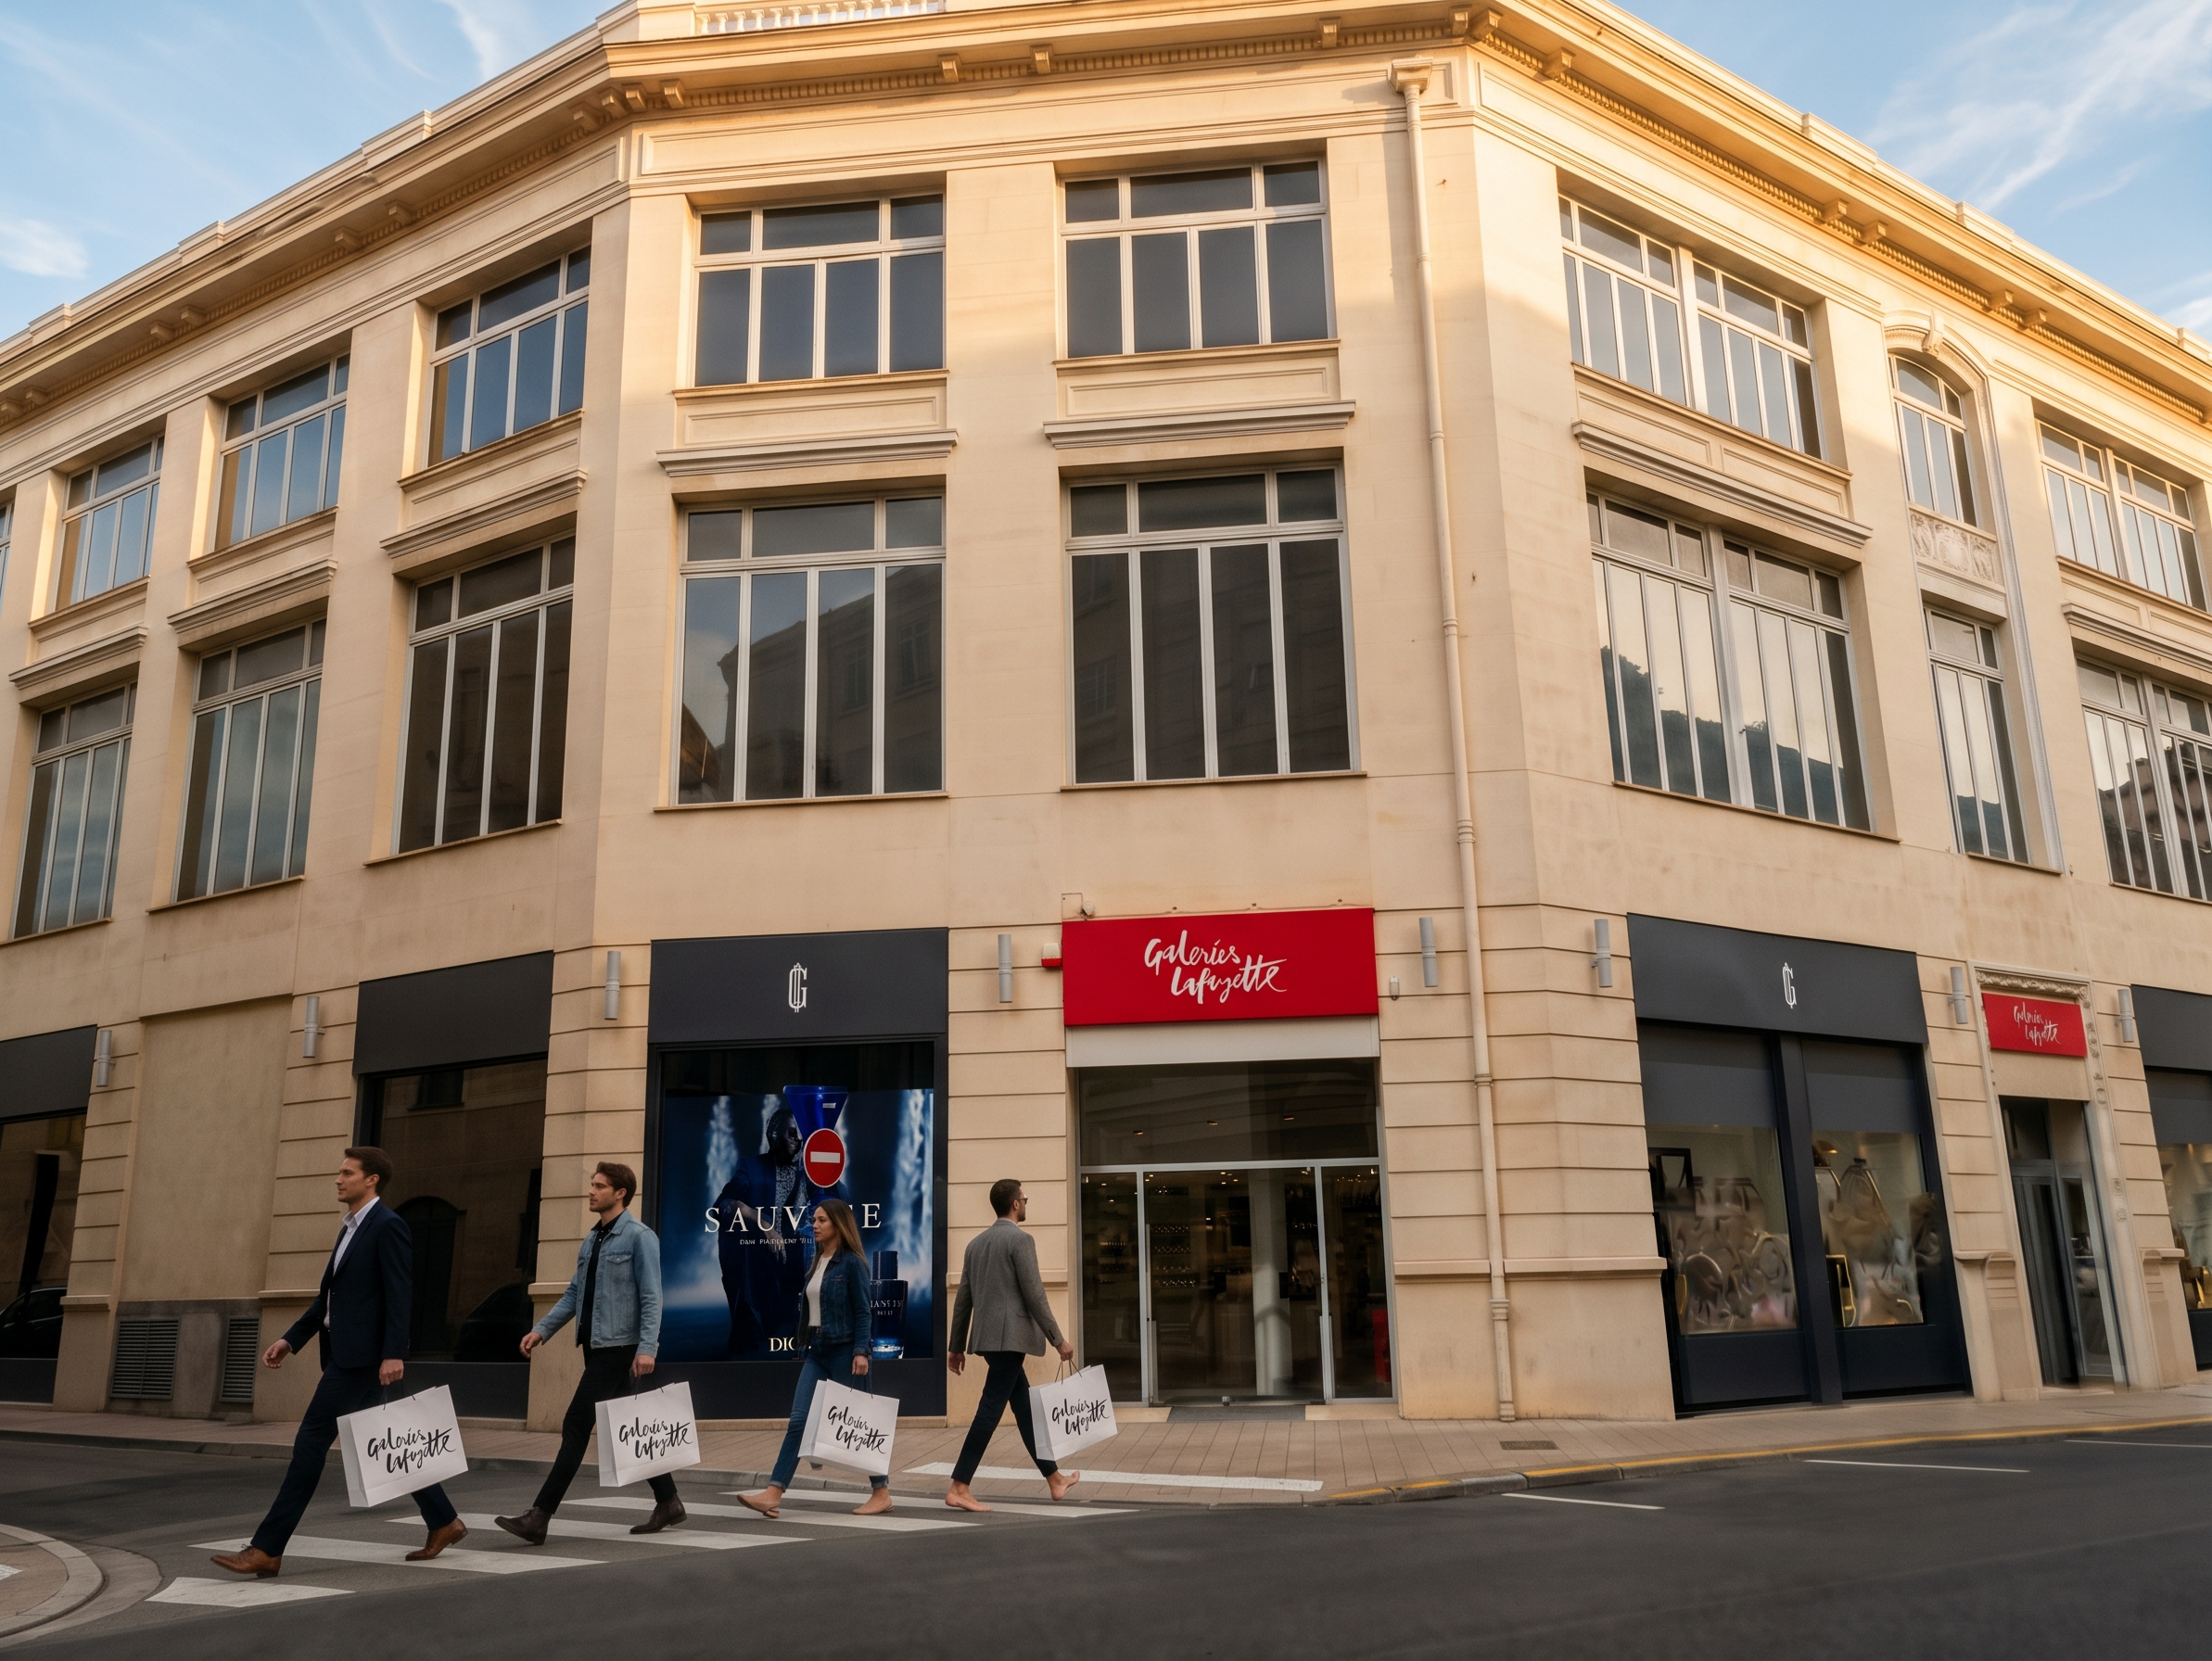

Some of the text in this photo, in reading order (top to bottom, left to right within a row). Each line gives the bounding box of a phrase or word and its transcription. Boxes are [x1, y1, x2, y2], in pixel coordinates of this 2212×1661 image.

[1144, 930, 1241, 976] Galeries
[1170, 955, 1288, 1005] Lafayette
[705, 1203, 882, 1234] SAUVE
[769, 1337, 812, 1352] DI
